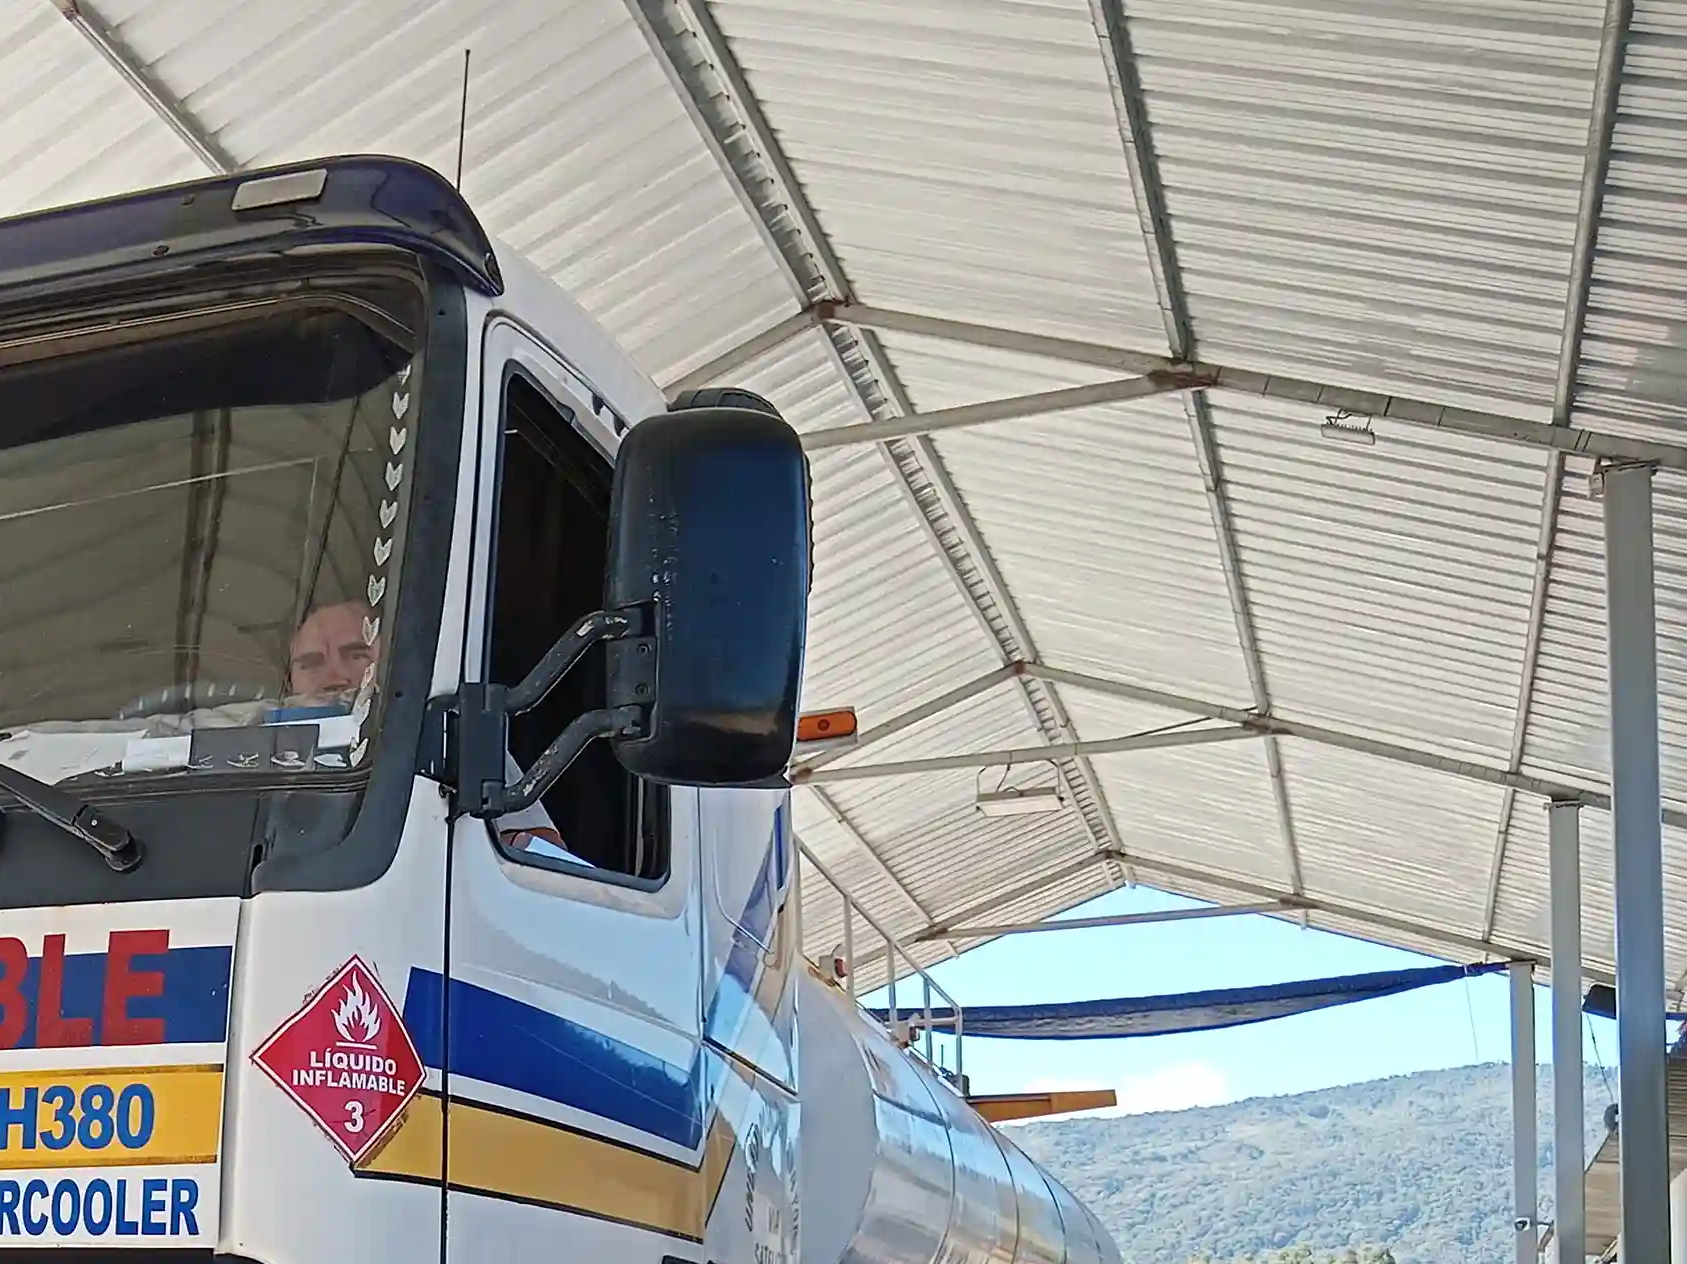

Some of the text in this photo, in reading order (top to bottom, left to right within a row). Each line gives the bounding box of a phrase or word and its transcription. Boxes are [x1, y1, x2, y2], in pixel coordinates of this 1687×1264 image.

[309, 1048, 397, 1076] LÍQUIDO
[292, 1070, 406, 1097] INFLAMABLE
[343, 1100, 364, 1133] 3
